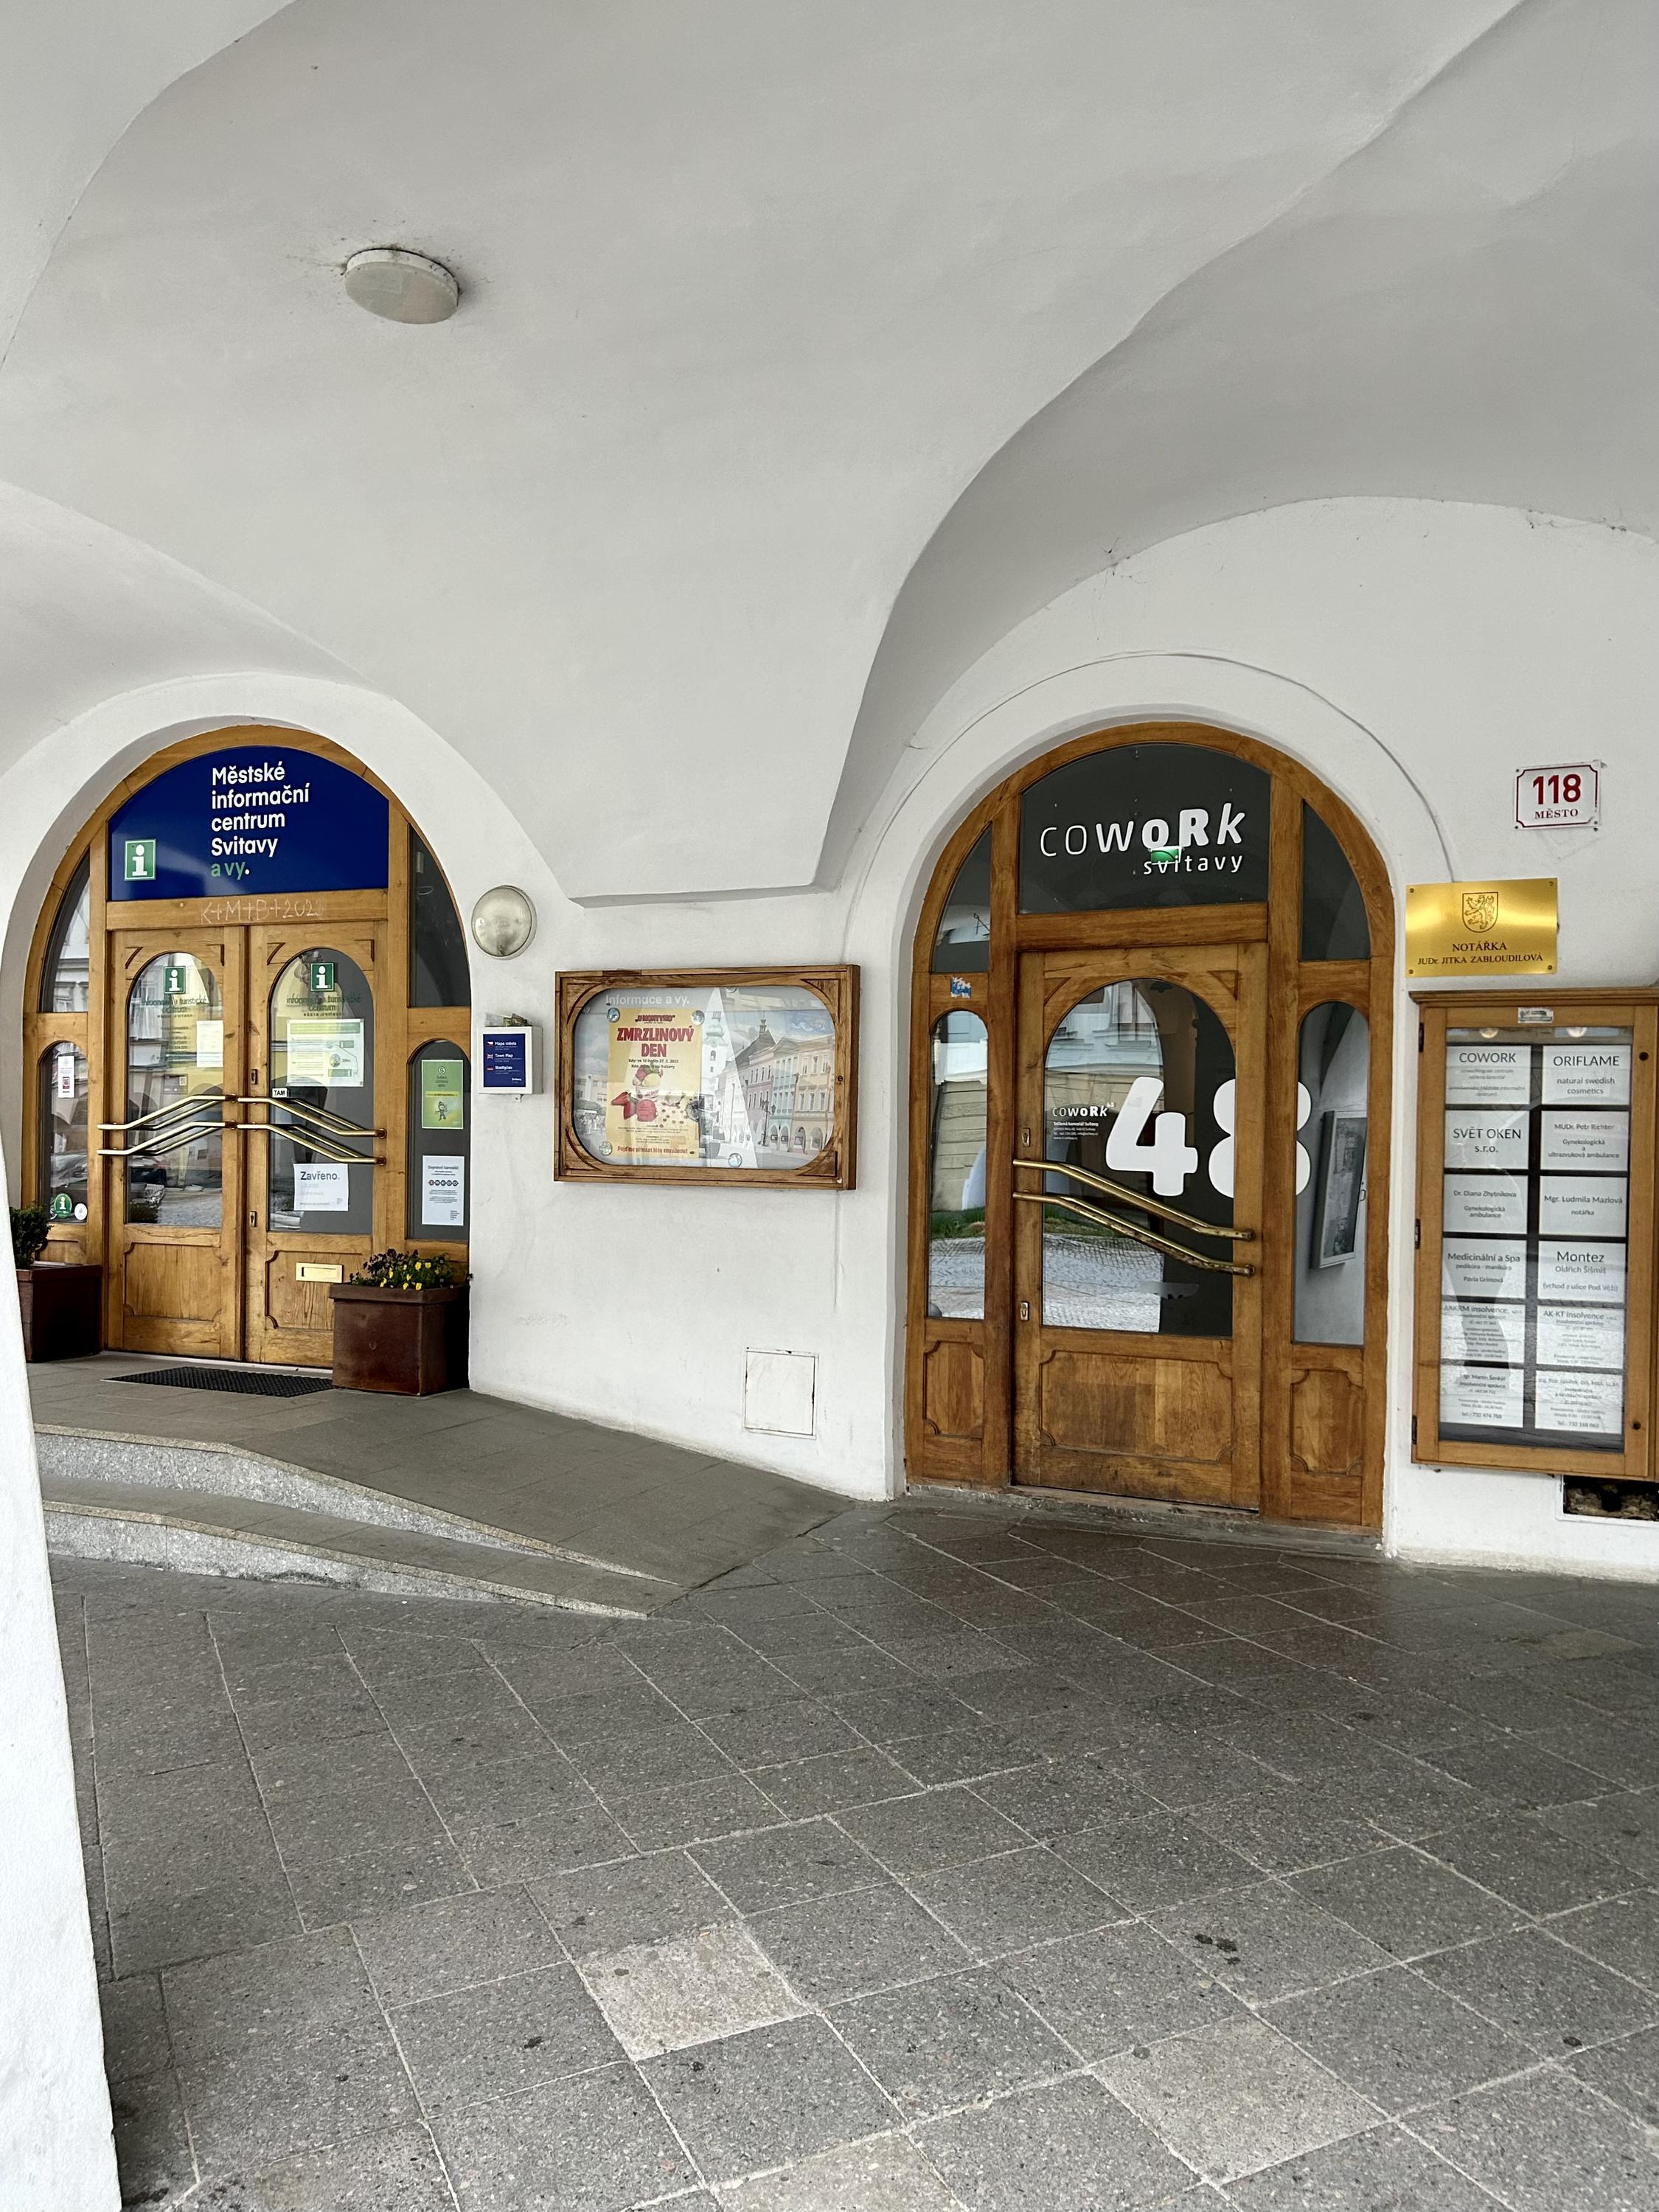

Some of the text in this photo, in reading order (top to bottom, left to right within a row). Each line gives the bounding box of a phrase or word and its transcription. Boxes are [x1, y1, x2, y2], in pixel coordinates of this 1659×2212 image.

[212, 761, 285, 786] Městské
[1533, 773, 1582, 805] 118
[212, 782, 310, 810] informační
[1534, 808, 1579, 819] MĚSTO
[211, 813, 285, 832] centrum
[211, 835, 279, 858] Svitavy
[211, 861, 250, 880] a vy.
[1144, 855, 1242, 874] svitavy
[1452, 941, 1507, 952] NOTÁŘKA
[1470, 952, 1543, 963] ZABLOUDILOVÁ
[606, 995, 662, 1004] Informace
[616, 1025, 694, 1042] ZMRZLINOVÝ
[641, 1043, 667, 1057] DEN
[1459, 1052, 1516, 1062] COWORK
[1553, 1056, 1620, 1066] ORIFLAME
[1453, 1126, 1521, 1139] SVĚT OKEN
[1544, 1195, 1560, 1203] Mgr.
[1447, 1253, 1496, 1262] Medicinální
[1505, 1254, 1520, 1263] Spa
[1557, 1251, 1605, 1262] Montez
